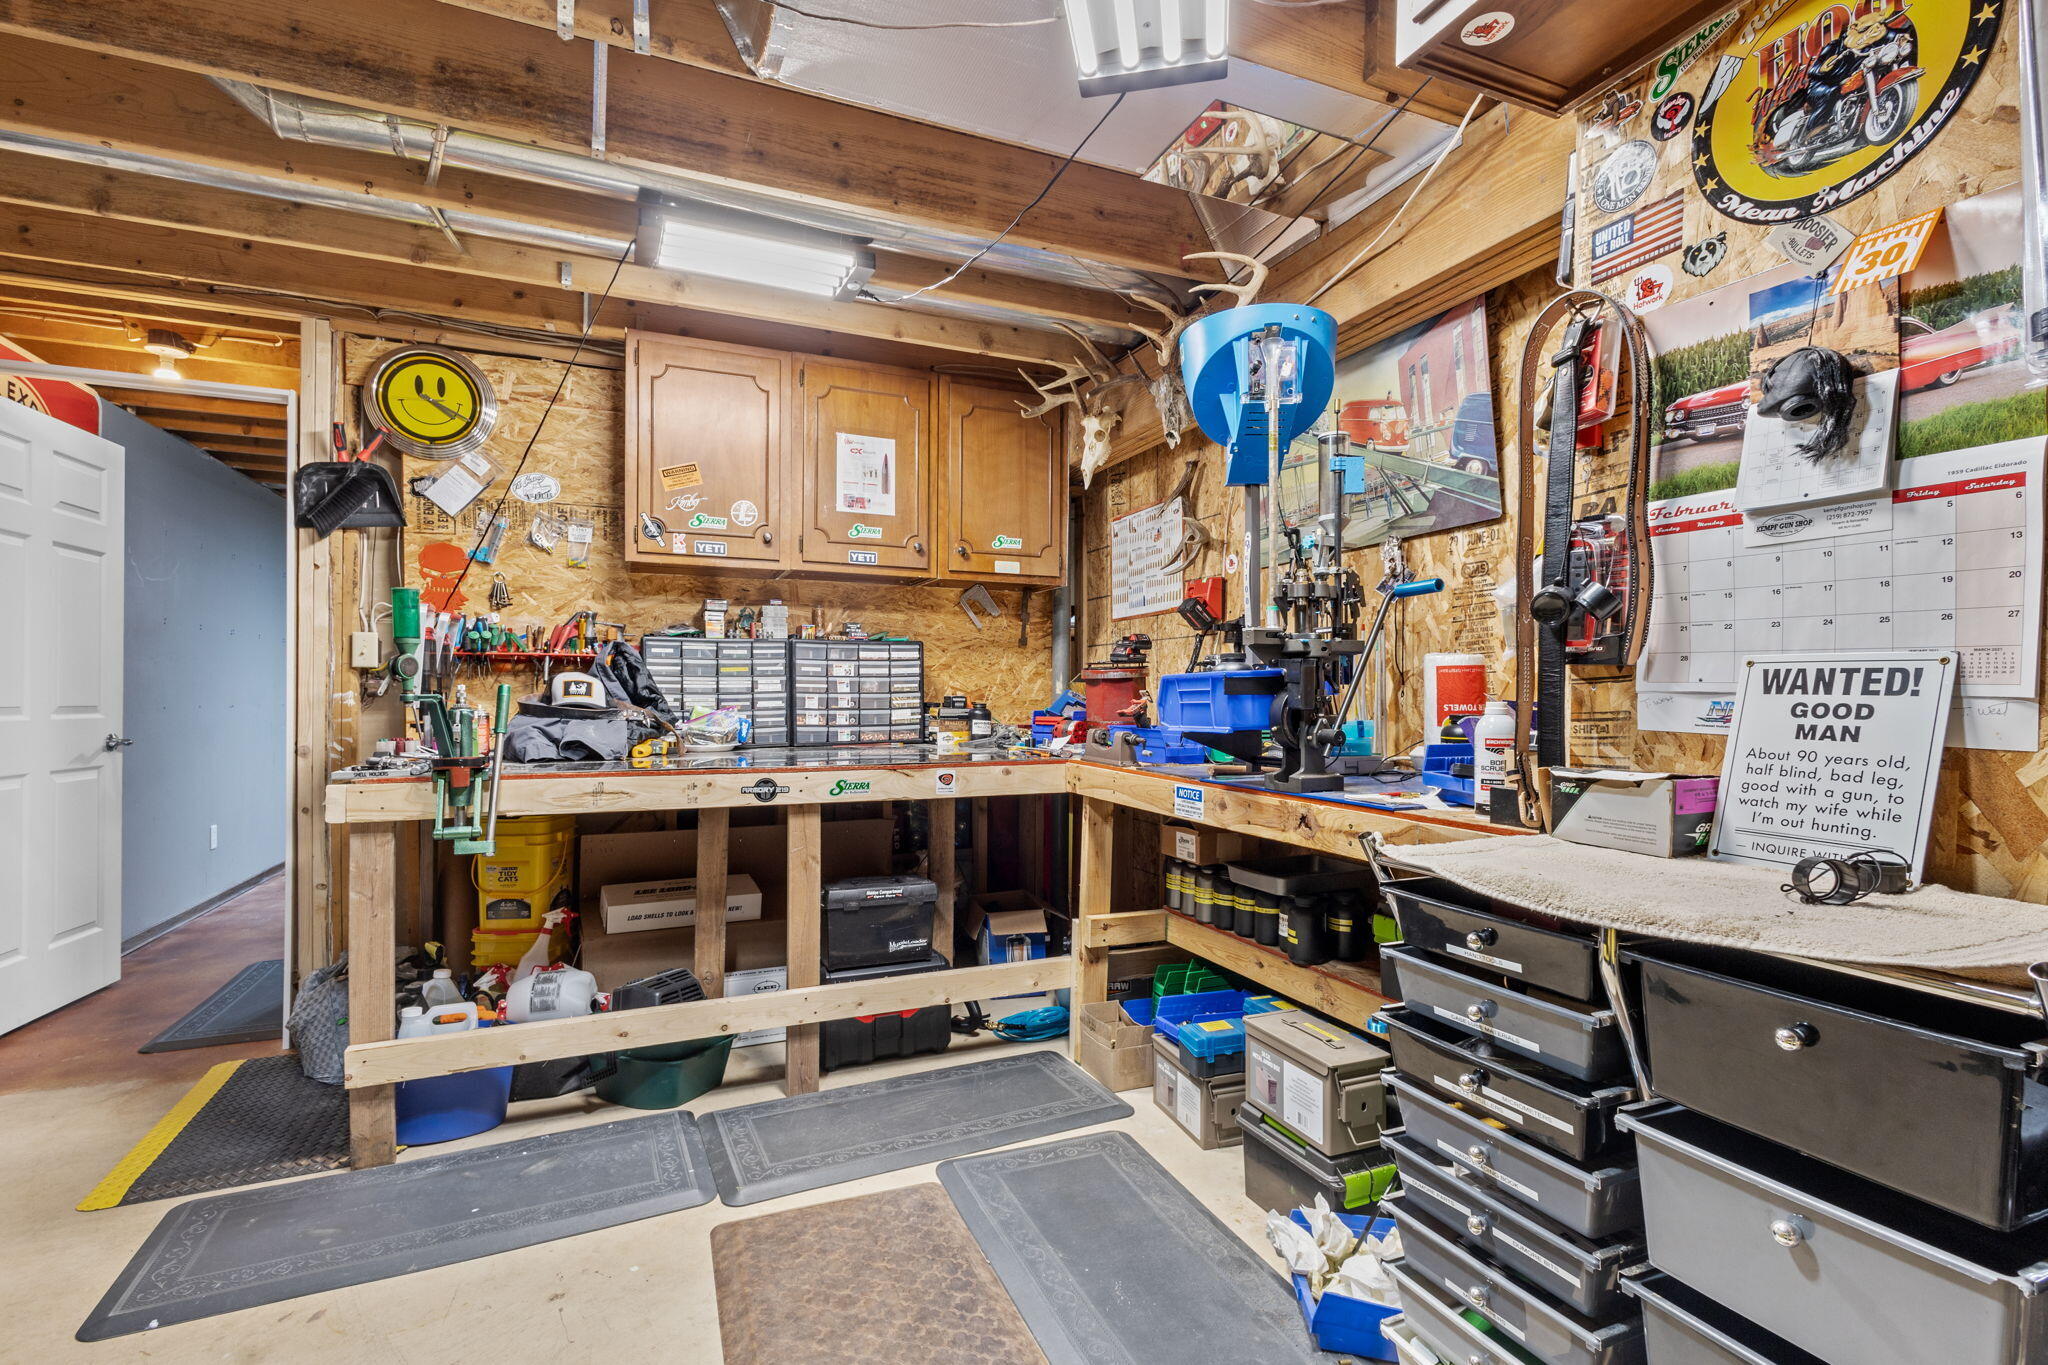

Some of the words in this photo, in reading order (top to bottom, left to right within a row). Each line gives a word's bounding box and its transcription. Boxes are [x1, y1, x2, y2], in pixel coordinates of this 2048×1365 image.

[1717, 194, 1800, 222] Mean
[1810, 87, 1961, 214] Machine
[1595, 219, 1631, 246] UNITED
[1792, 216, 1838, 253] HOOSIER
[1595, 242, 1609, 258] WE
[1609, 233, 1631, 252] ROLL
[1855, 241, 1908, 275] 30
[1633, 294, 1664, 310] Hotwork
[1965, 464, 1992, 474] Cadillac
[1994, 460, 2027, 469] Eldorado
[1907, 488, 1941, 499] Friday
[1965, 479, 2016, 490] Saturday
[2016, 491, 2023, 499] 6
[1823, 501, 1877, 513] kempfgunshop.com
[1947, 500, 1953, 508] 5
[690, 513, 727, 527] SIERRA
[1779, 521, 1794, 529] GUN
[1794, 518, 1813, 528] SHOP
[1826, 512, 1842, 521] (219)
[850, 524, 881, 538] SIERRA
[1656, 526, 1681, 534] Sunday
[1697, 519, 1725, 528] Monday
[993, 535, 1021, 548] SIERRA
[1942, 538, 1954, 546] 12
[2010, 530, 2023, 539] 13
[696, 544, 725, 554] YETI
[1823, 550, 1833, 558] 10
[1879, 544, 1889, 552] 11
[850, 553, 876, 563] YETI
[1880, 580, 1890, 588] 18
[2008, 570, 2022, 579] 20
[1823, 618, 1833, 626] 24
[1941, 613, 1953, 621] 26
[2008, 610, 2021, 618] 27
[1762, 667, 1924, 697] WANTED!
[1443, 703, 1478, 713] TOWELS
[1790, 702, 1875, 721] GOOD
[1794, 724, 1861, 743] MAN
[1746, 747, 1791, 761] About
[1797, 750, 1818, 763] 90
[1824, 755, 1869, 768] years
[1876, 755, 1911, 771] old,
[1746, 762, 1774, 776] half
[1779, 764, 1822, 782] blind,
[1830, 768, 1864, 784] bad
[1871, 771, 1904, 790] leg,
[741, 786, 775, 794] ARMORY
[829, 780, 870, 796] SIERRA
[1178, 787, 1200, 800] NOTICE
[1741, 780, 1780, 793] good
[1786, 783, 1817, 797] with
[1824, 789, 1834, 798] a
[1842, 791, 1879, 805] gun,
[1888, 793, 1904, 805] to
[1739, 797, 1779, 809] watch
[1786, 801, 1808, 815] my
[1815, 803, 1848, 817] wife
[1857, 807, 1902, 823] while
[1752, 811, 1774, 825] I'm
[1780, 817, 1805, 829] out
[1812, 818, 1877, 841] hunting.
[1751, 842, 1807, 859] INQUIRE
[627, 914, 642, 922] LOAD
[643, 911, 665, 920] SHELLS
[674, 909, 689, 917] LOOK
[727, 905, 743, 913] NEW!
